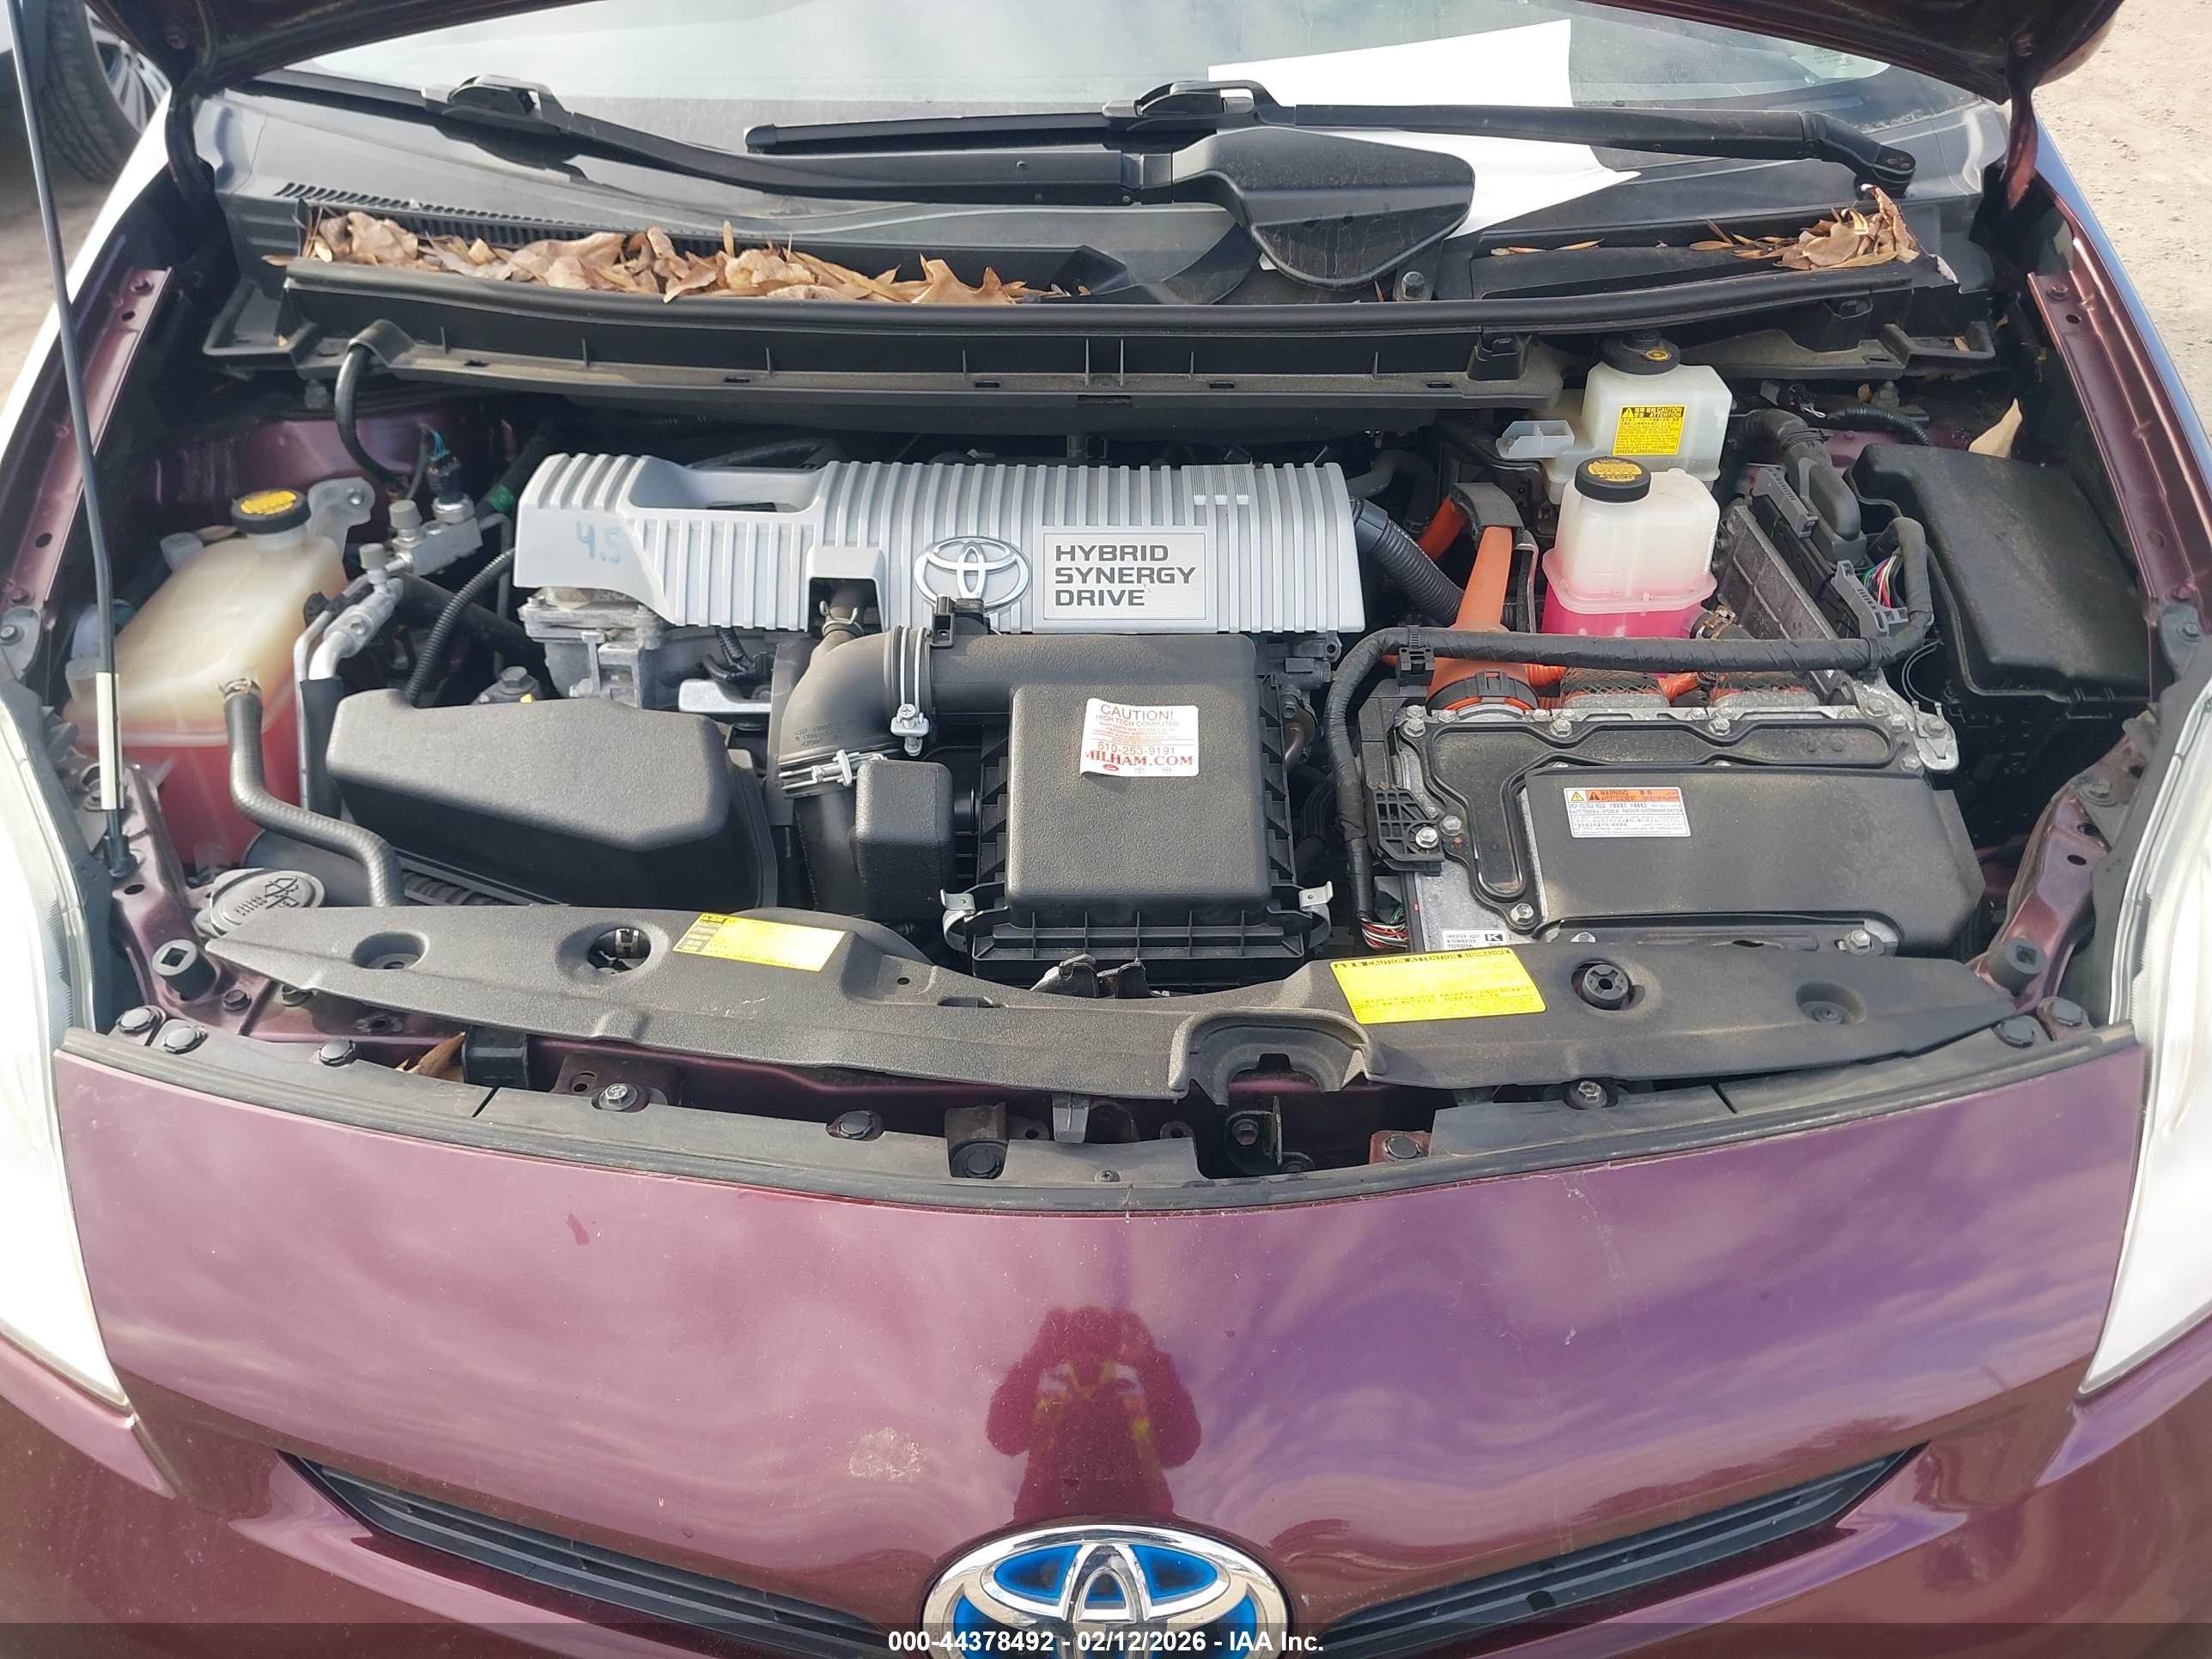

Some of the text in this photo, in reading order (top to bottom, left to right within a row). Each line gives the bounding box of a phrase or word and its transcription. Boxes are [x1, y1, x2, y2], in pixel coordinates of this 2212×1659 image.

[1055, 545, 1169, 562] HYBRID
[1055, 567, 1196, 584] SYNERGY
[1055, 590, 1145, 606] DRIVE
[1101, 704, 1174, 721] CAUTION!
[1115, 718, 1134, 726] TECH
[1368, 957, 1406, 967] CAUTION
[1410, 953, 1458, 963] ATTENTION
